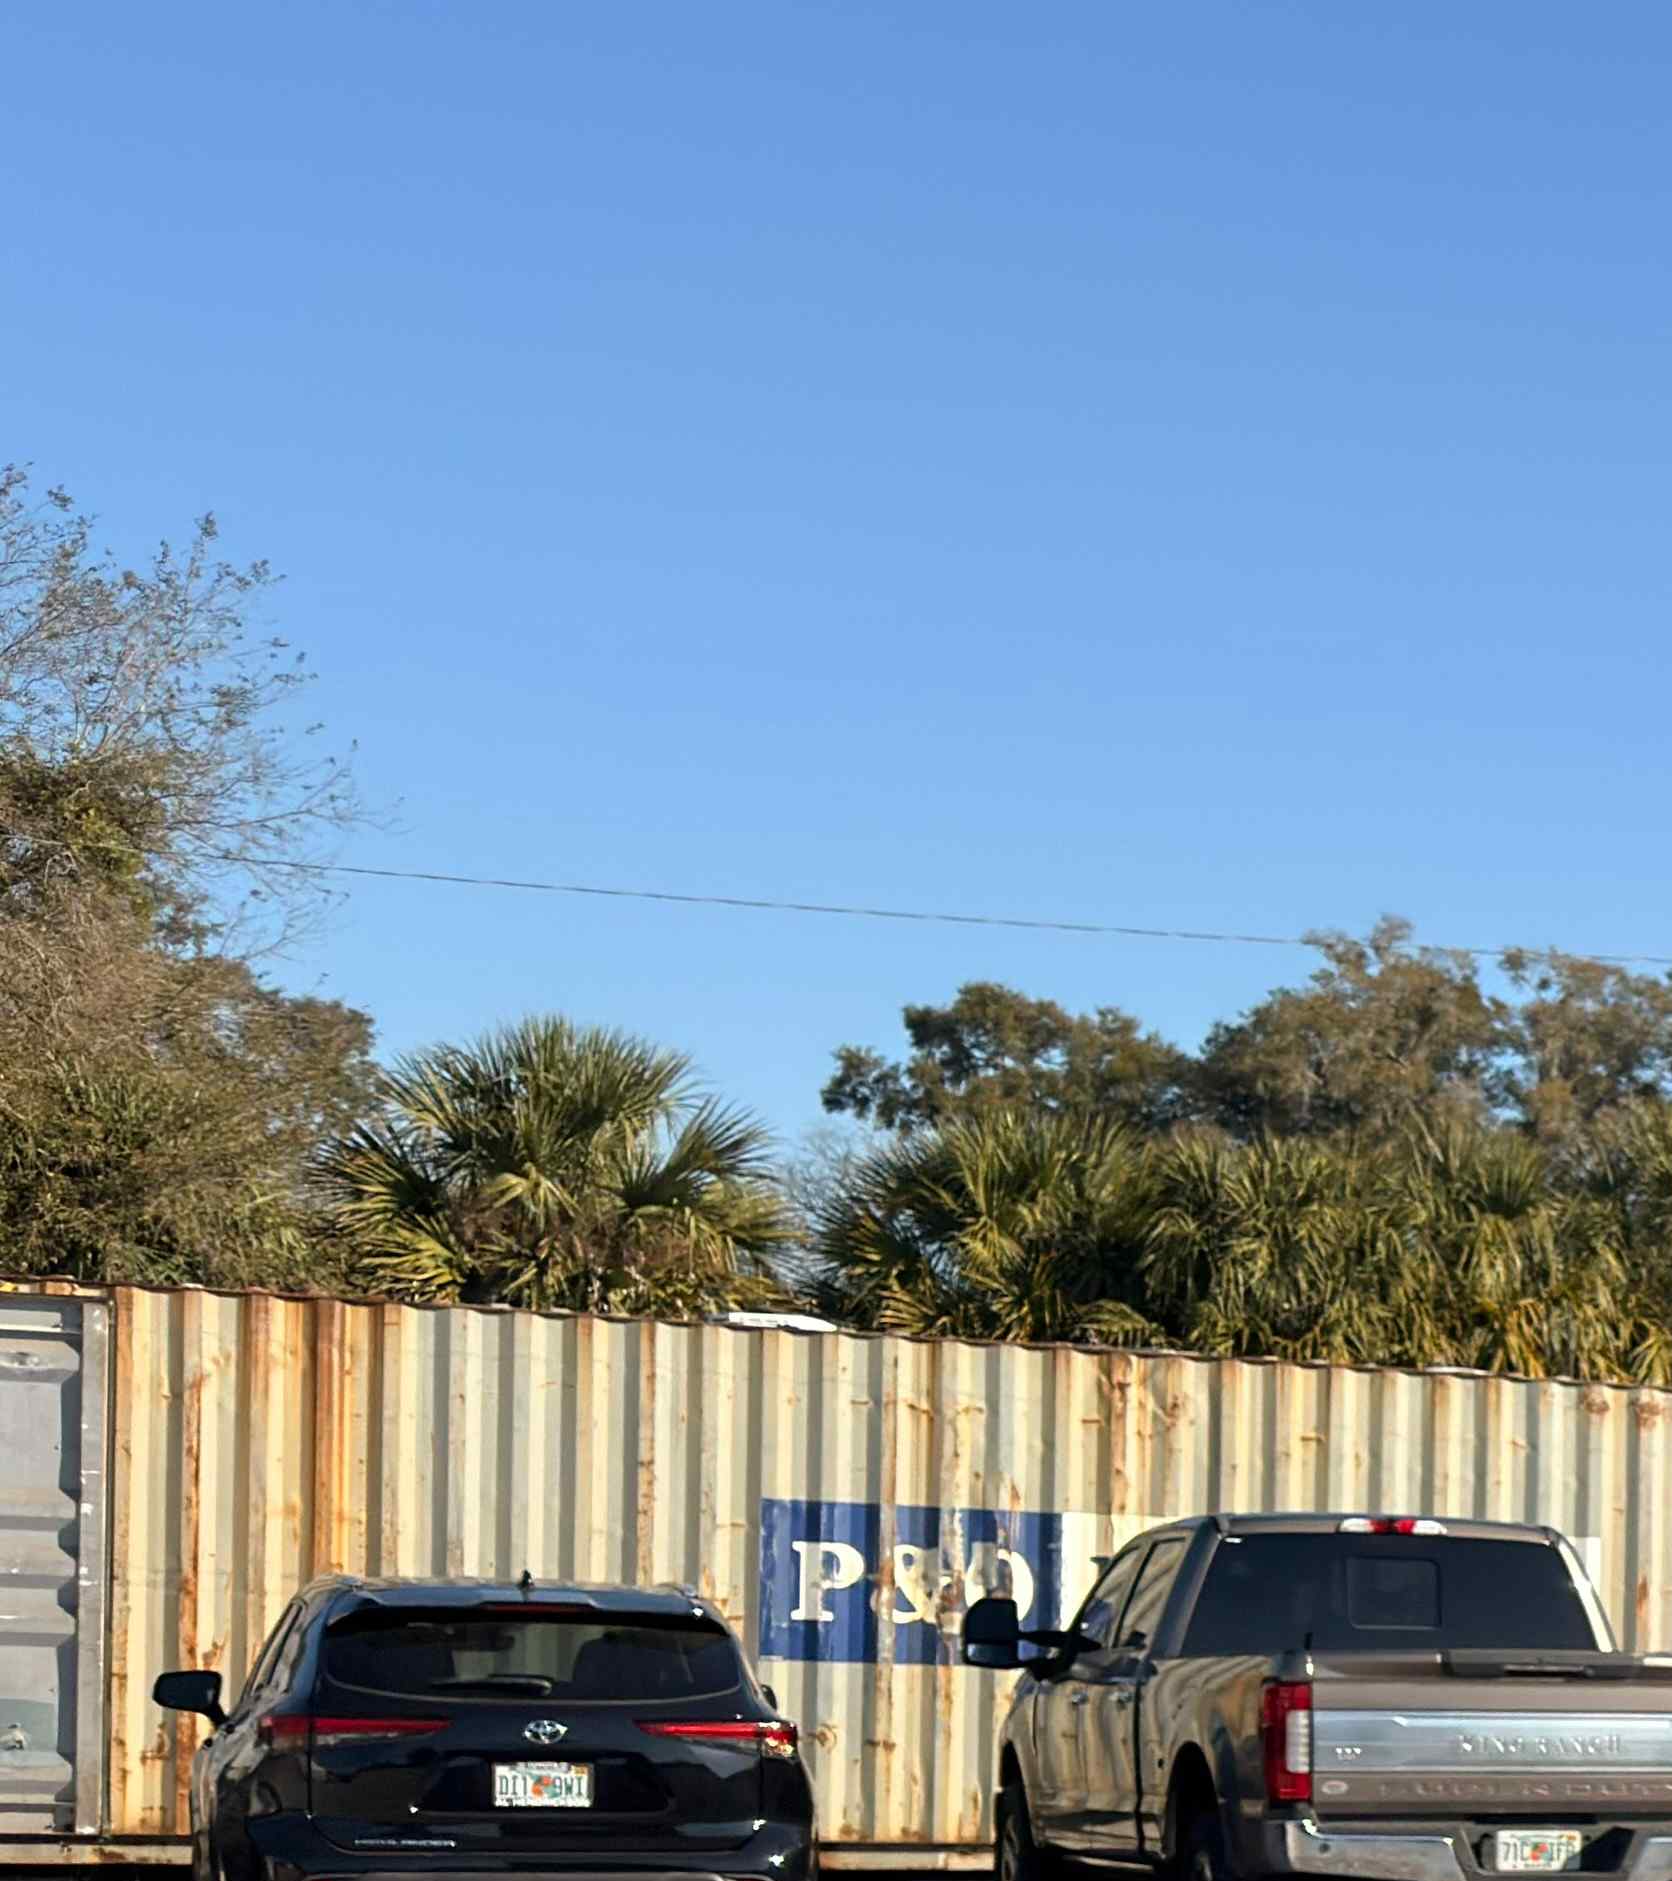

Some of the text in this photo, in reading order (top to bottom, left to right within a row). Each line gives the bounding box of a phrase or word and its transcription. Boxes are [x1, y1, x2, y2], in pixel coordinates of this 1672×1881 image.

[790, 1540, 1034, 1624] P&O
[1458, 1735, 1621, 1753] KING RANCH
